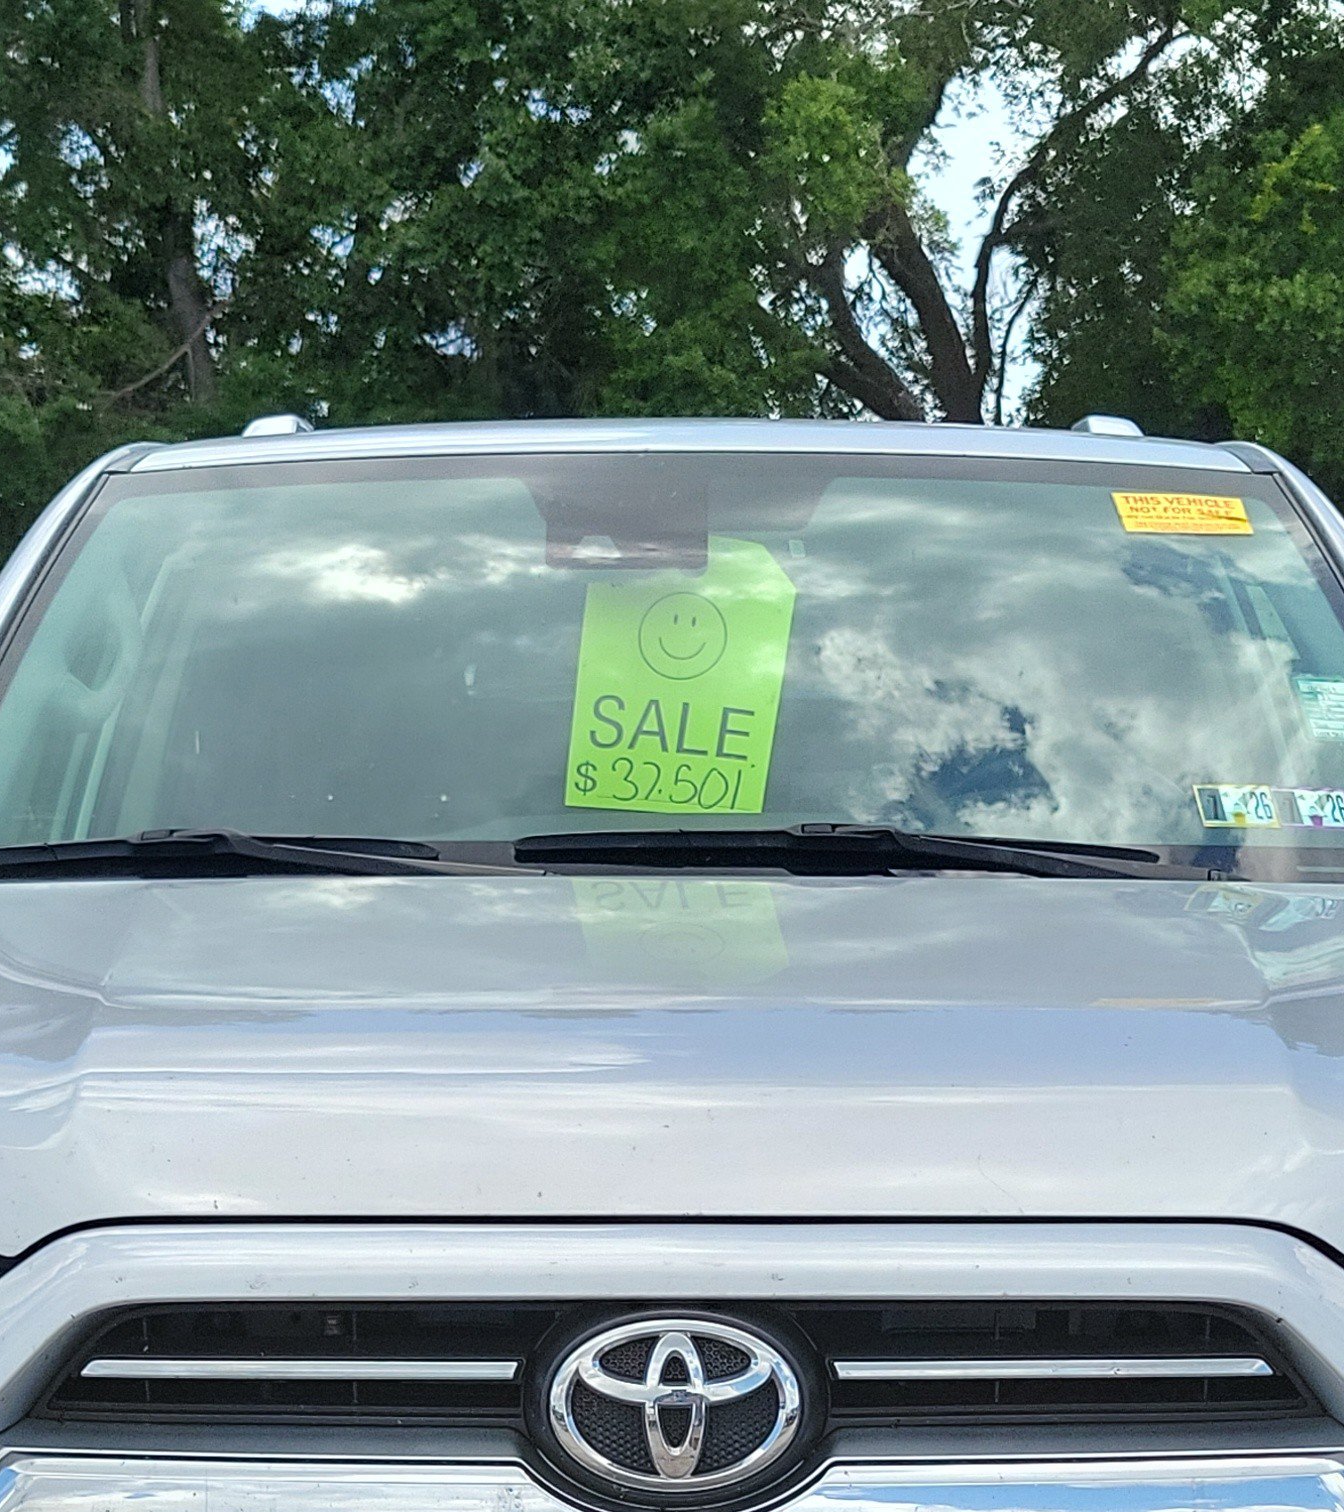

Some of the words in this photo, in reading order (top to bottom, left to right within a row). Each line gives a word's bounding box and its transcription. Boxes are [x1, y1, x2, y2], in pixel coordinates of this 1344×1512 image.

[1121, 495, 1161, 506] THIS
[1164, 497, 1235, 509] VEHICLE
[1163, 506, 1191, 515] FOR
[589, 694, 755, 761] SALE
[1249, 791, 1273, 820] 26
